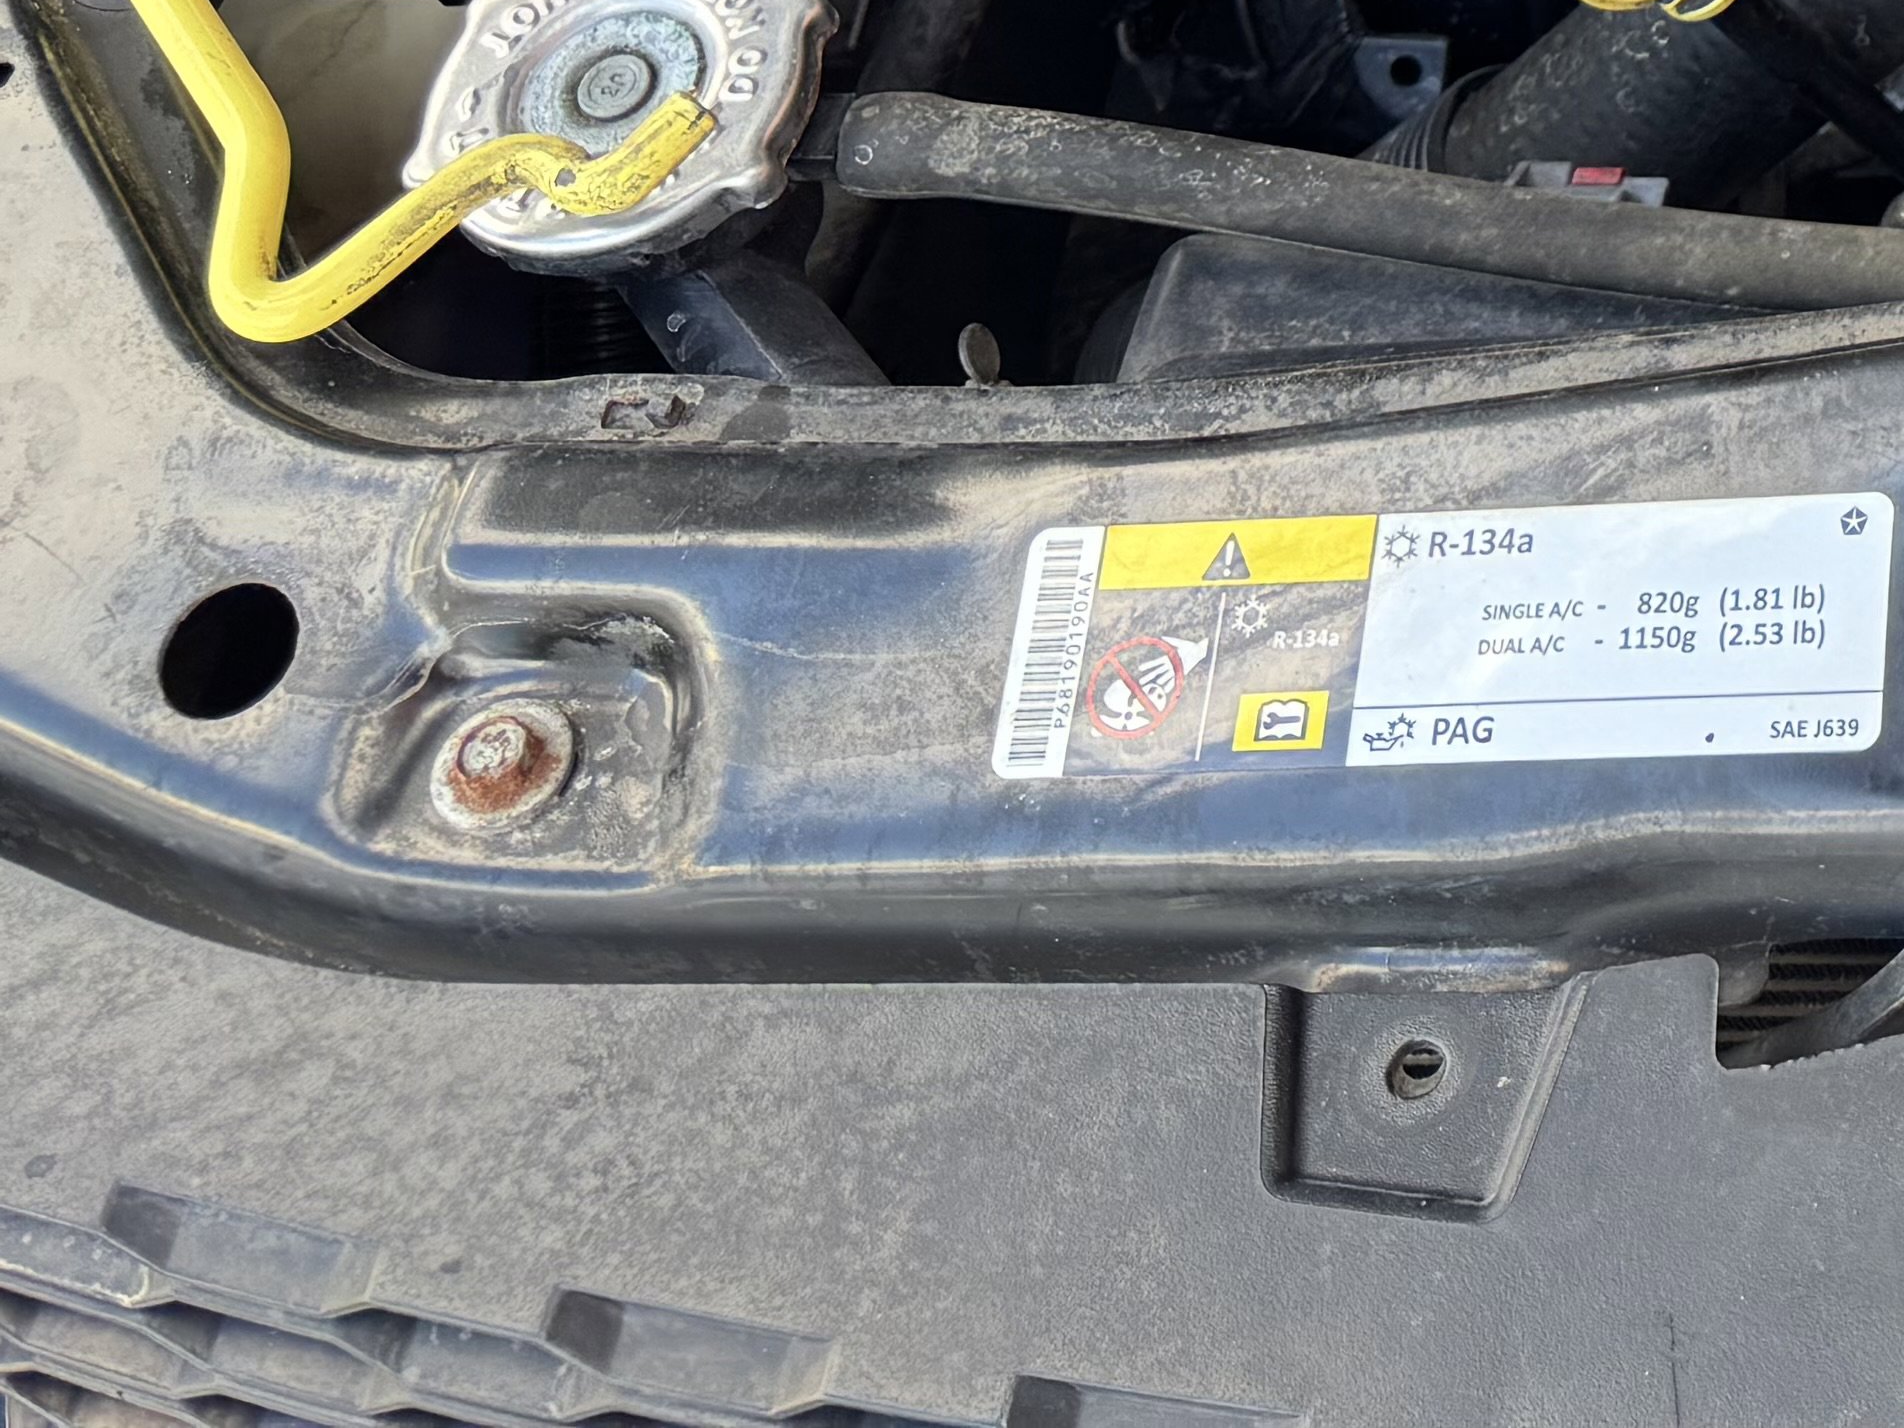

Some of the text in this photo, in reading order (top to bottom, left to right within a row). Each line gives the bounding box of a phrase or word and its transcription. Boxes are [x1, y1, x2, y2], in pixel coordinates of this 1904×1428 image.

[718, 44, 768, 104] DO
[1428, 528, 1534, 558] R-134a
[1482, 584, 1826, 621] SINGLE A/C 820g (1.81 lb)
[1054, 572, 1094, 728] P68190190AA
[1272, 629, 1340, 649] R-134a
[1477, 619, 1826, 656] DUAL A/C 1150g (2.53 lb)
[1431, 716, 1860, 746] PAG SAE J639
